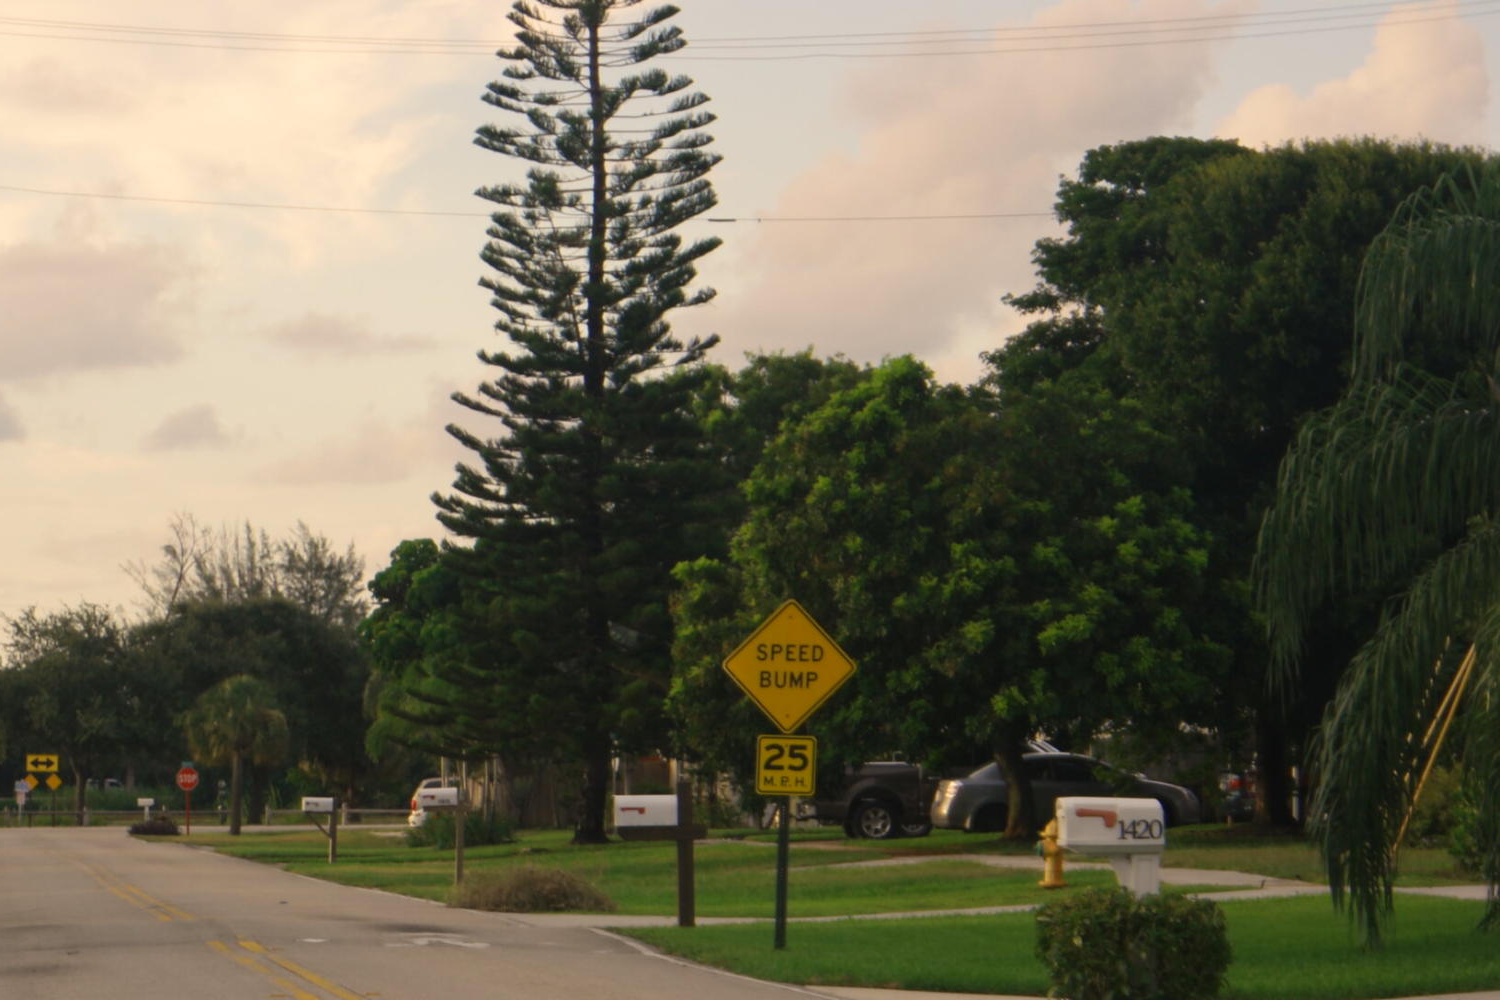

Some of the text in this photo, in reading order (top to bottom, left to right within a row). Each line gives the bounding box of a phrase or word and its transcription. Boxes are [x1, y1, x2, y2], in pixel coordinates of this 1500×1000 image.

[756, 643, 824, 662] SPEED
[760, 671, 818, 689] BUMP
[764, 743, 809, 771] 25
[1117, 819, 1163, 840] 1420
